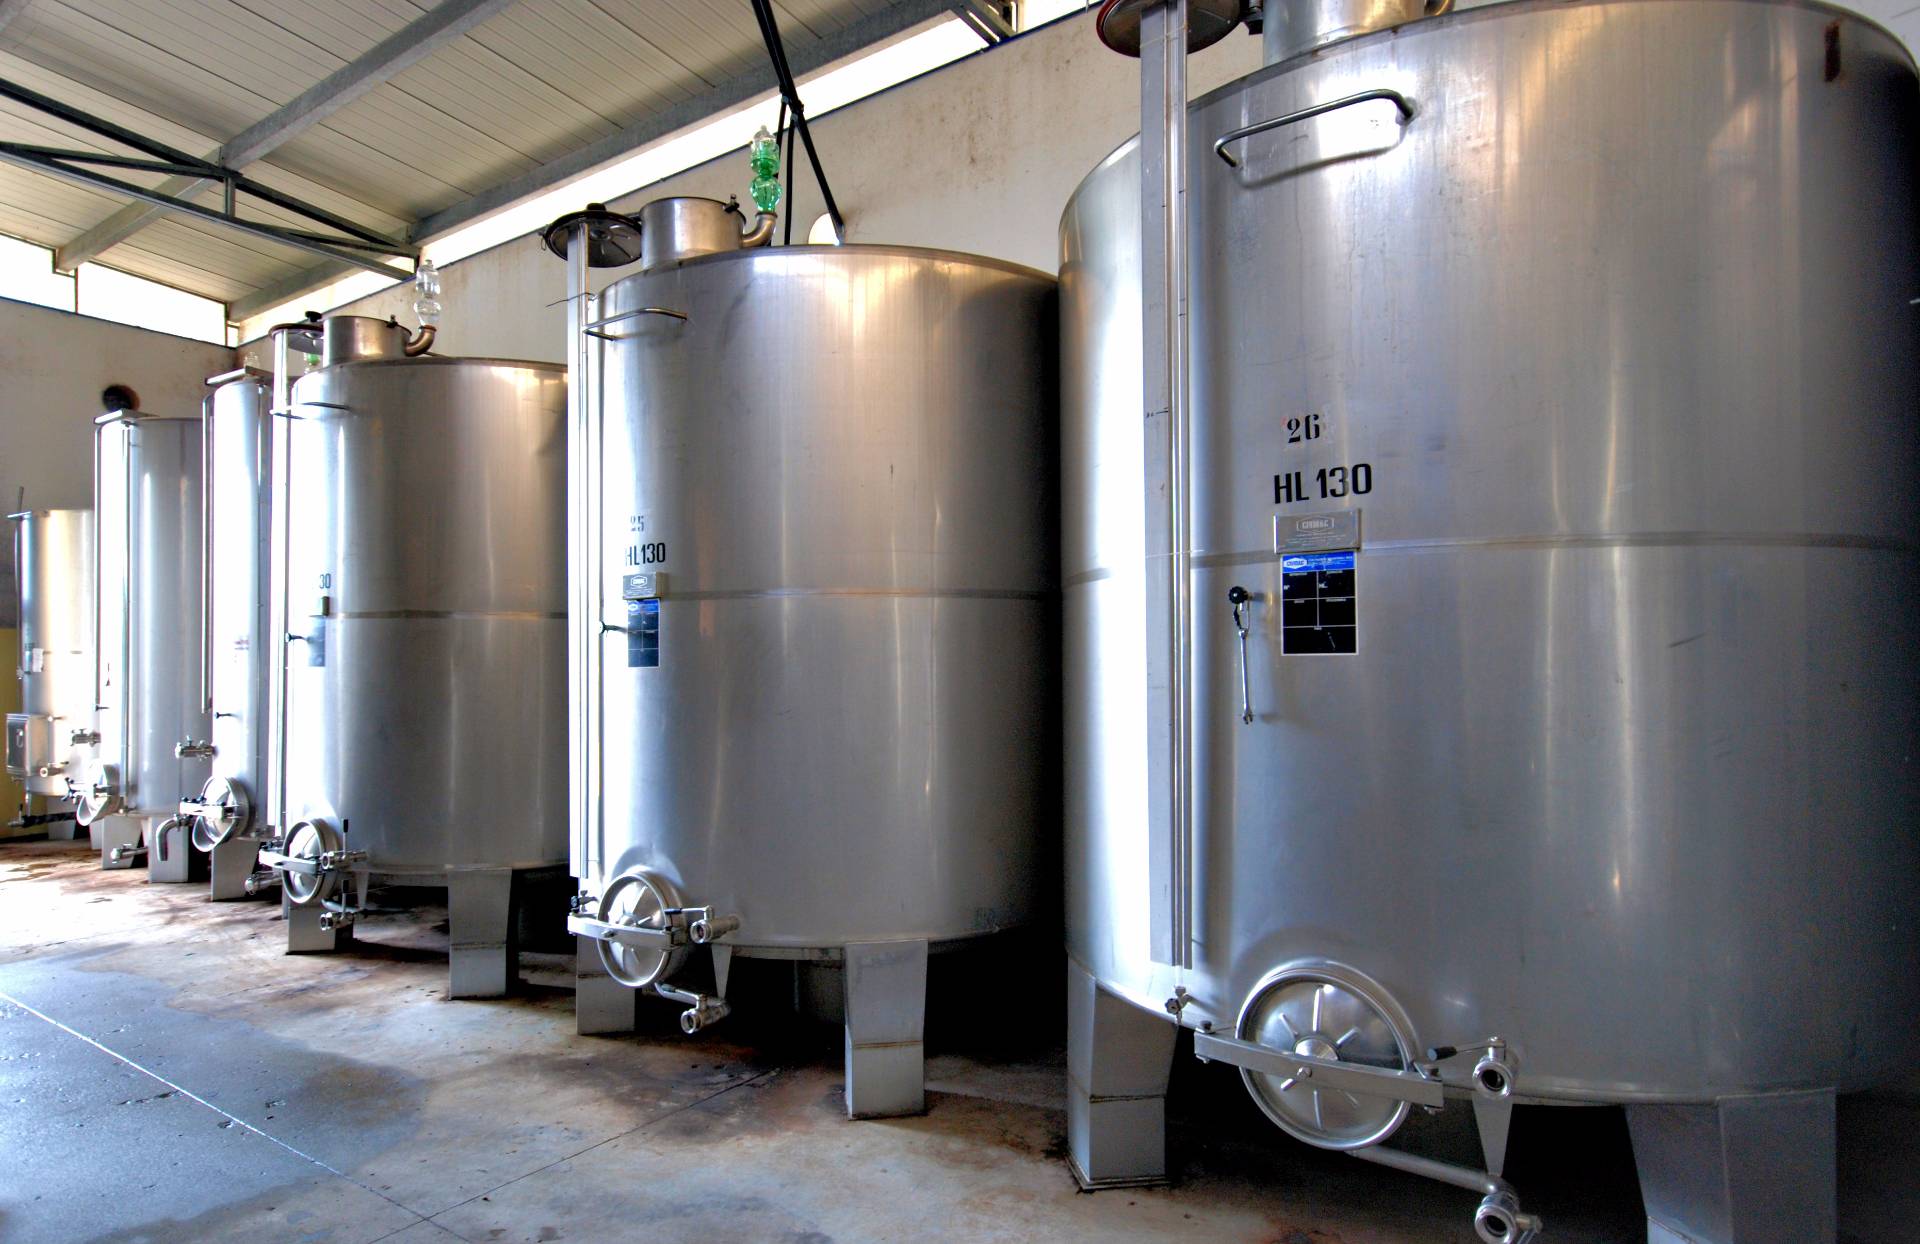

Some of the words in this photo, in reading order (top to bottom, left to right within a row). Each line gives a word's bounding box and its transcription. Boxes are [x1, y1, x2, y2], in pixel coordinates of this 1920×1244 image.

[1287, 414, 1320, 443] 26
[1274, 471, 1309, 504] HL
[1316, 463, 1372, 498] 130
